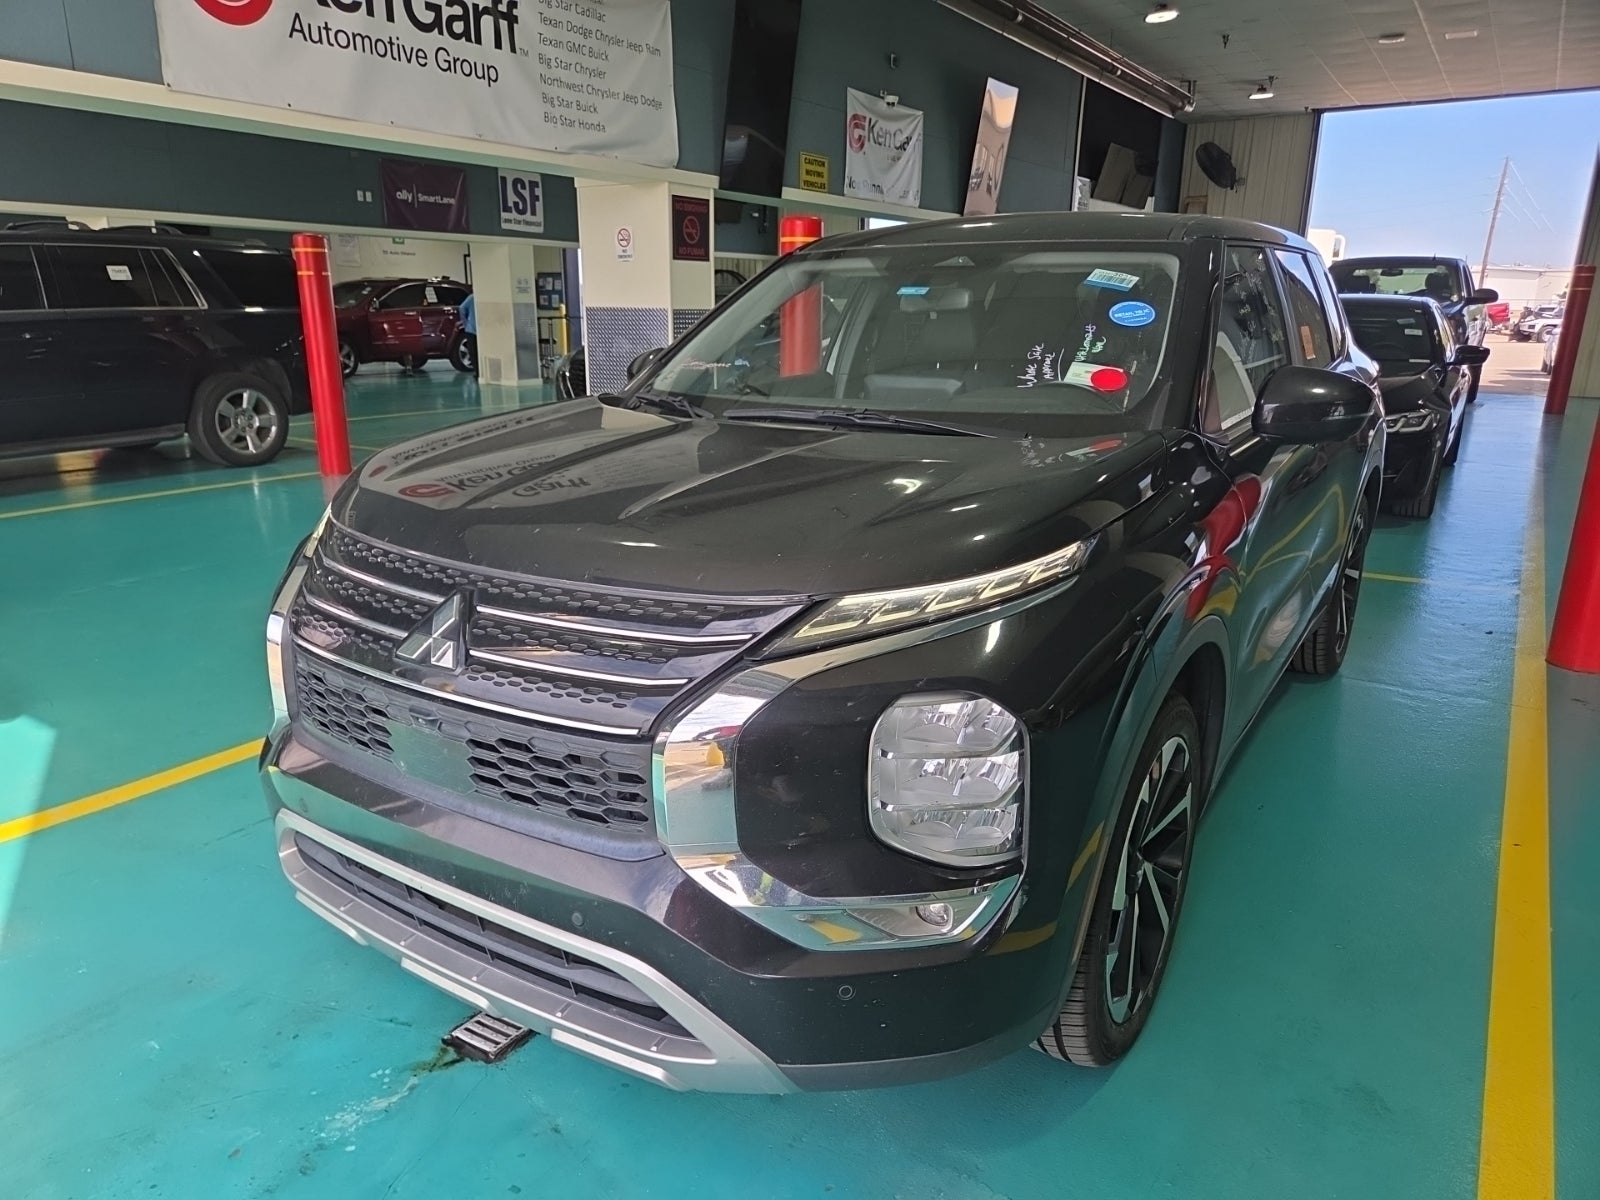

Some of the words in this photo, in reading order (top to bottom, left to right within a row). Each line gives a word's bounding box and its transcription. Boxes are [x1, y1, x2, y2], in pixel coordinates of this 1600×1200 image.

[555, 0, 572, 11] Star
[575, 3, 606, 22] Cadillac
[538, 11, 563, 30] Texan
[567, 20, 593, 39] Dodge
[595, 29, 624, 47] Chrysler
[626, 37, 643, 54] Jeep
[289, 12, 428, 67] Automotive
[435, 46, 499, 87] Group
[537, 32, 564, 49] Texan
[566, 40, 587, 55] GMC
[589, 46, 609, 62] Buick
[538, 52, 552, 69] Big
[554, 57, 572, 71] Star
[574, 62, 606, 79] Chrysler
[540, 73, 584, 93] Northwest
[586, 84, 620, 100] Chrysler
[623, 91, 639, 106] Jeep
[640, 94, 662, 110] Dodge
[542, 92, 556, 108] Big
[557, 96, 574, 109] Star
[576, 100, 598, 114] Buick
[560, 115, 576, 128] Star
[578, 118, 607, 133] Honda
[804, 157, 826, 168] CAUTION
[805, 169, 825, 178] MOVING
[803, 180, 826, 190] VEHICLES
[396, 189, 413, 203] ally
[417, 193, 456, 206] SmartLane
[500, 176, 541, 217] LSF
